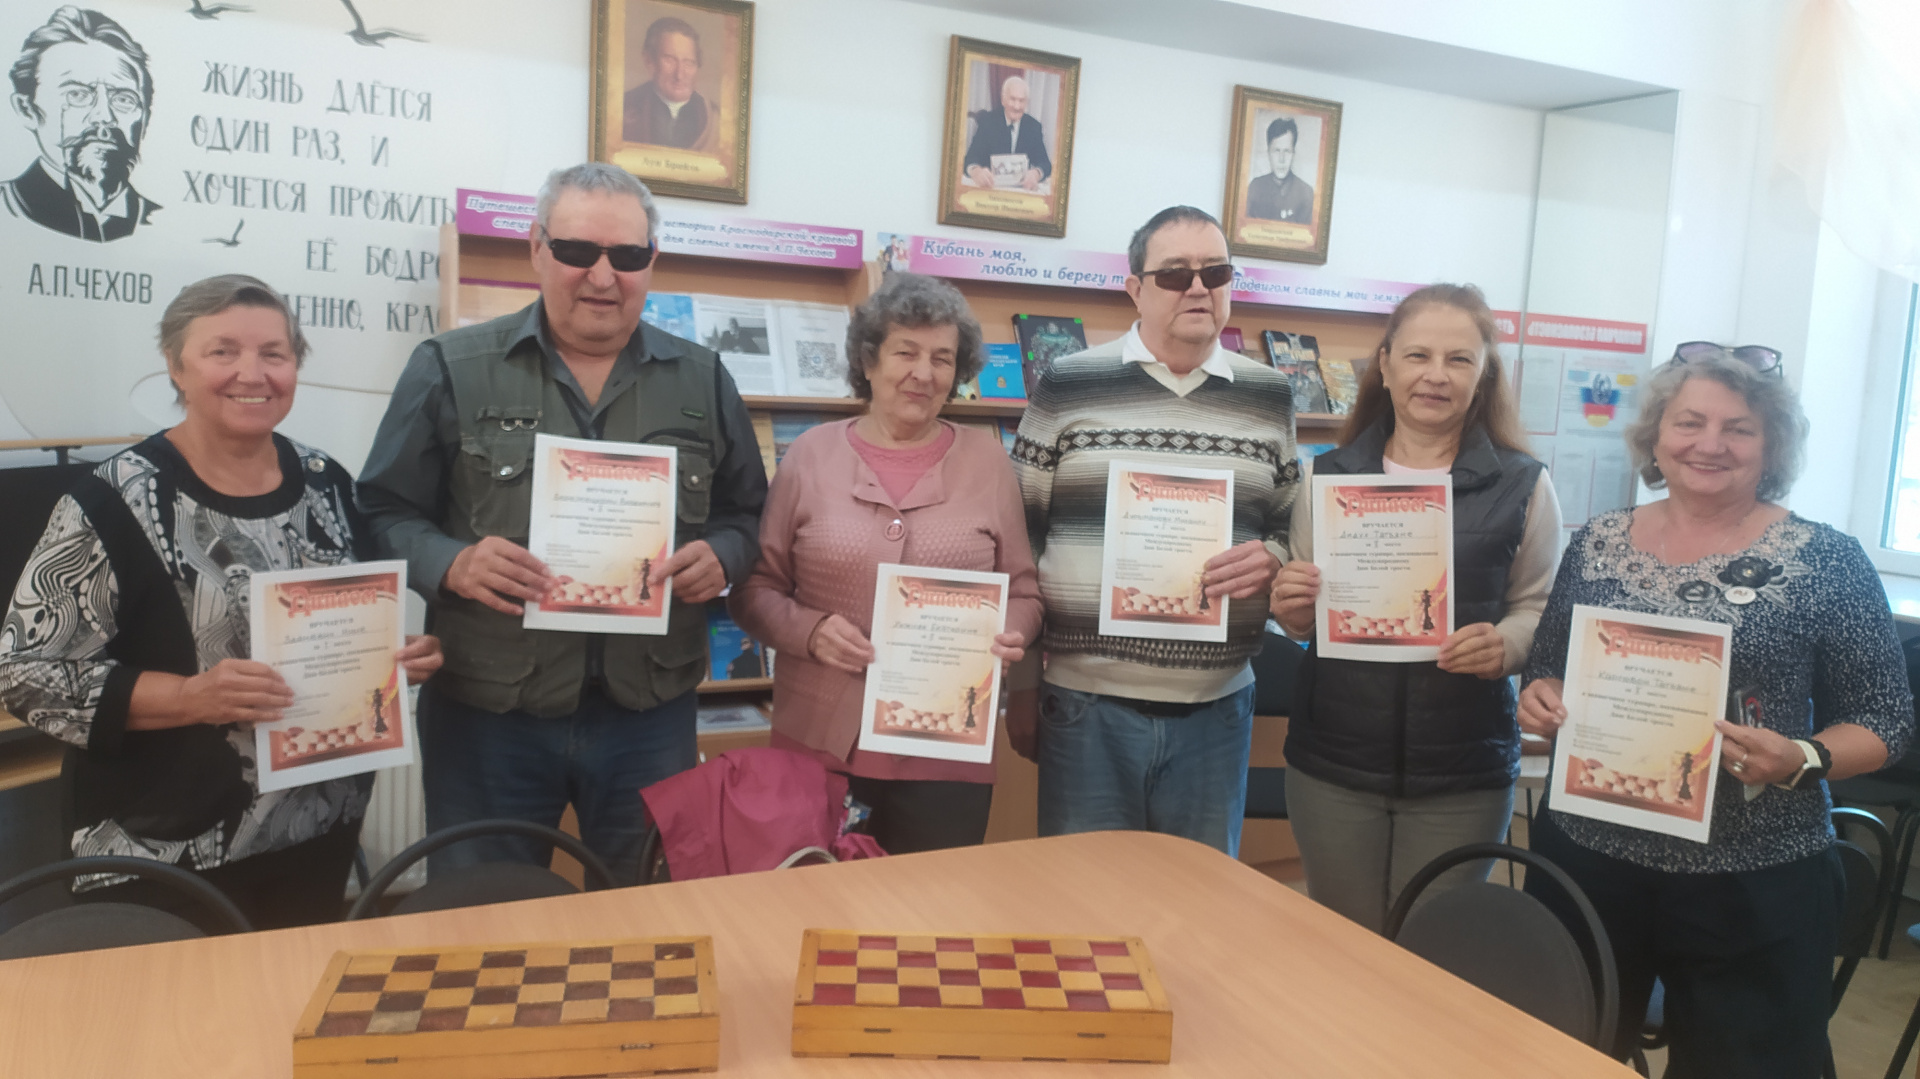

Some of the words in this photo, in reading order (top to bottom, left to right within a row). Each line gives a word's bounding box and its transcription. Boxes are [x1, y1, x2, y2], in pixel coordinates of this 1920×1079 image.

[203, 61, 303, 103] ЖИЗНЬ
[327, 79, 432, 122] ДАЁТСЯ
[190, 116, 270, 154] ОДИН
[292, 126, 346, 164] РАЗ,
[371, 135, 390, 167] И
[183, 170, 306, 213] ХОЧЕТСЯ
[330, 185, 457, 227] ПРОЖИТЬ
[720, 224, 807, 240] Краснодарской
[306, 237, 337, 273] ЕЁ
[922, 240, 985, 258] Кубань
[988, 249, 1027, 263] моя,
[28, 263, 153, 304] А.П.ЧЕХОВ
[980, 263, 1038, 279] люблю
[1043, 270, 1052, 279] и
[1057, 266, 1107, 287] берегу
[1111, 274, 1125, 285] т
[1231, 278, 1291, 295] Подвигом
[1295, 286, 1340, 299] славны
[1344, 290, 1369, 301] мои
[387, 302, 440, 334] КРА
